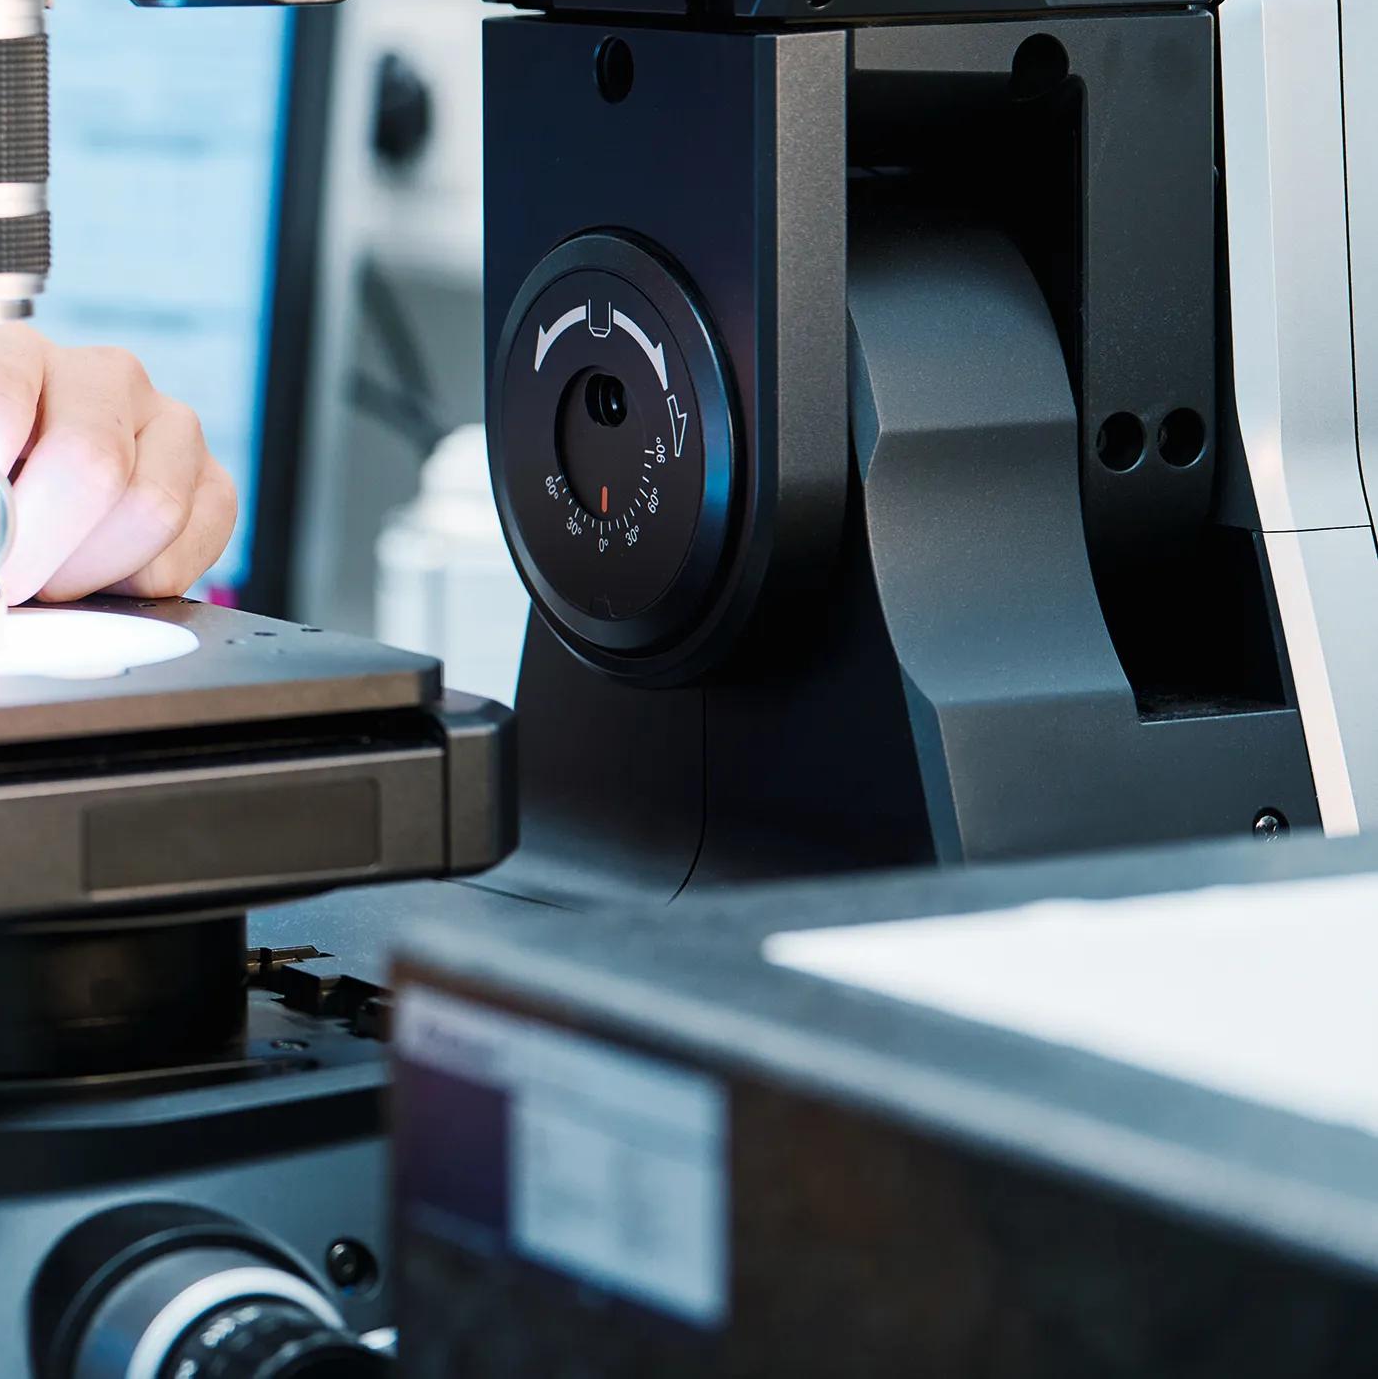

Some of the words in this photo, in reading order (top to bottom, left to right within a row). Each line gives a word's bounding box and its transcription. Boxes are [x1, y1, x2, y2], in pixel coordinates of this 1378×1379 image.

[655, 436, 666, 464] 90°
[545, 475, 559, 500] 60°
[647, 487, 659, 514] 60°
[566, 516, 582, 536] 30°
[625, 525, 640, 547] 30°
[598, 537, 609, 552] 0°
